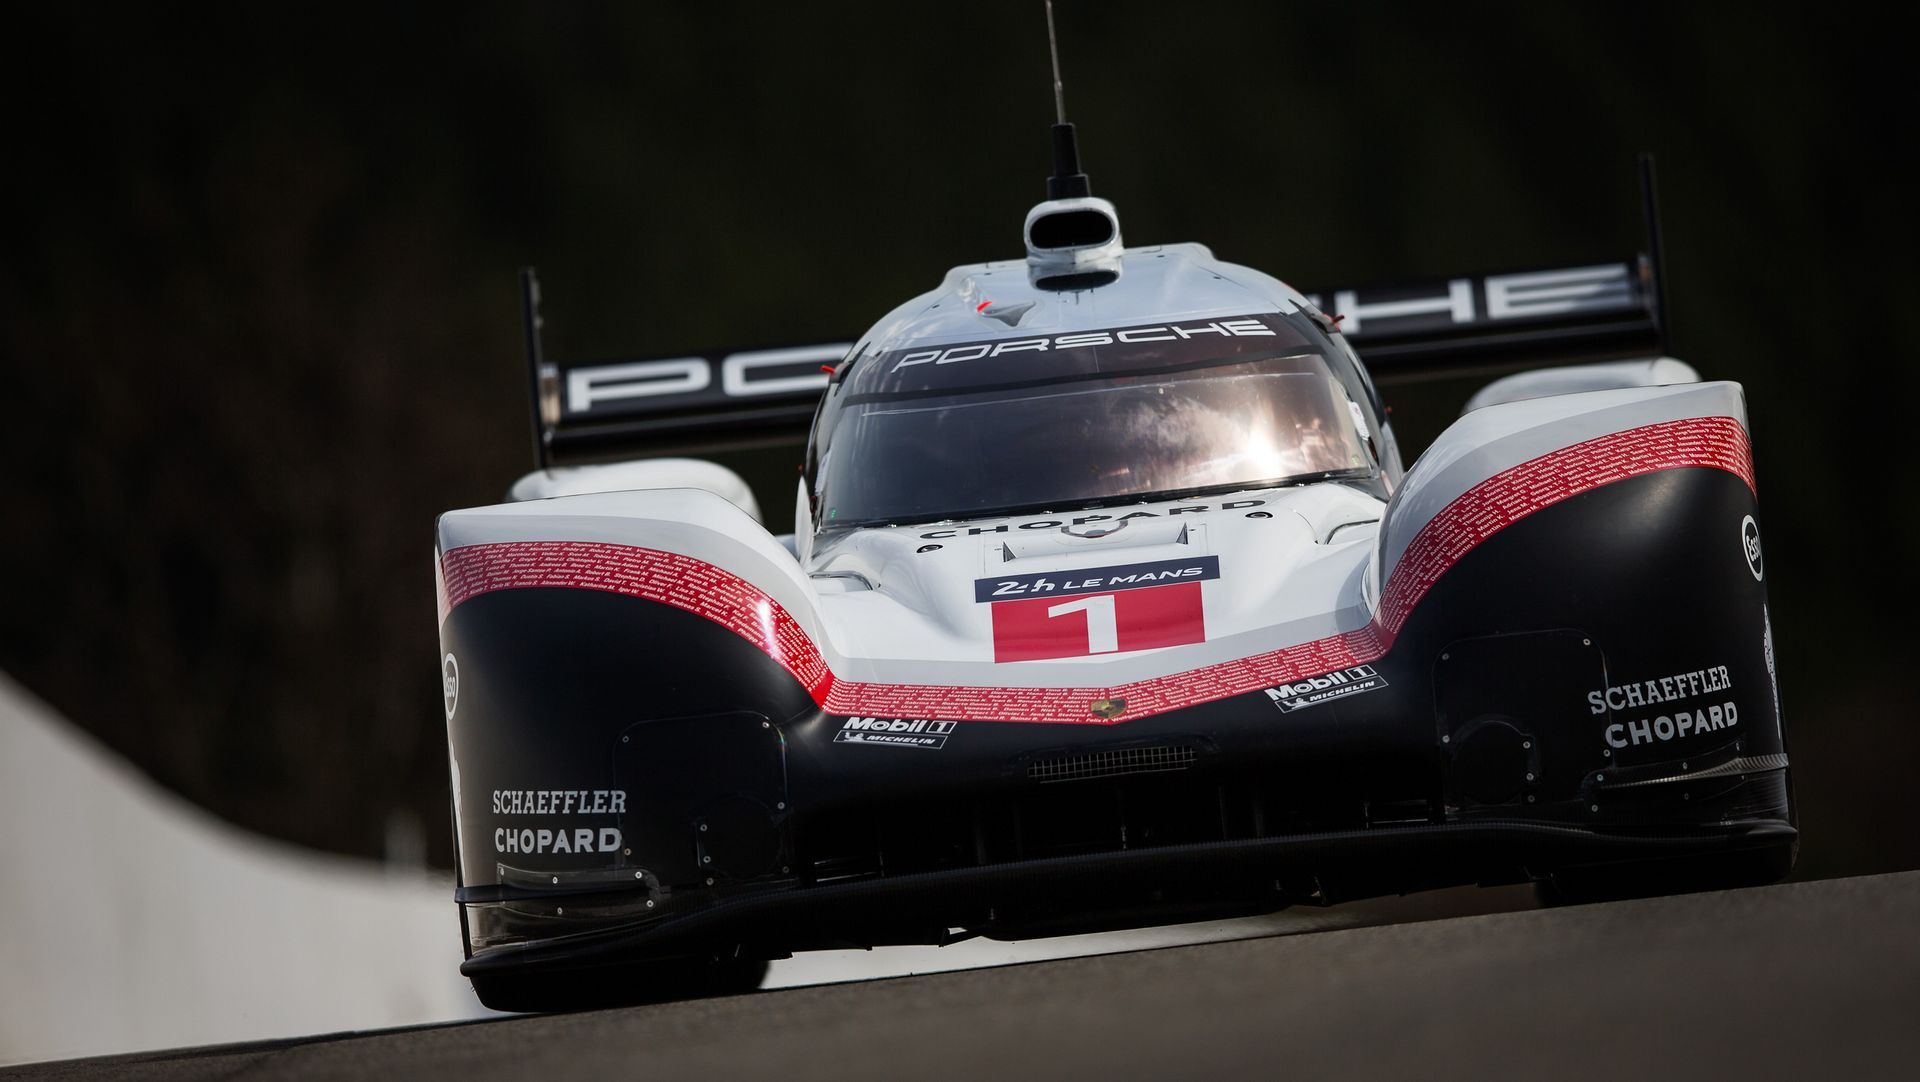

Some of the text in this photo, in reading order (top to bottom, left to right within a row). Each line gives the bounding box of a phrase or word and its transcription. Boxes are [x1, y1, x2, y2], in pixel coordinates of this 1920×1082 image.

[891, 319, 1276, 373] PORSCHE
[919, 499, 1266, 539] CHOPARD
[1063, 578, 1104, 590] LE
[1108, 566, 1204, 585] MANS
[1047, 594, 1119, 654] 1
[1264, 671, 1349, 701] Mobil
[1309, 680, 1375, 702] MICHELIN
[1587, 665, 1731, 715] SCHAEFFLER
[843, 716, 928, 734] Mobil
[1604, 701, 1738, 749] CHOPARD
[866, 734, 936, 745] MICHELIN
[492, 790, 627, 814] SCHAEFFLER
[494, 827, 624, 854] CHOPARD
